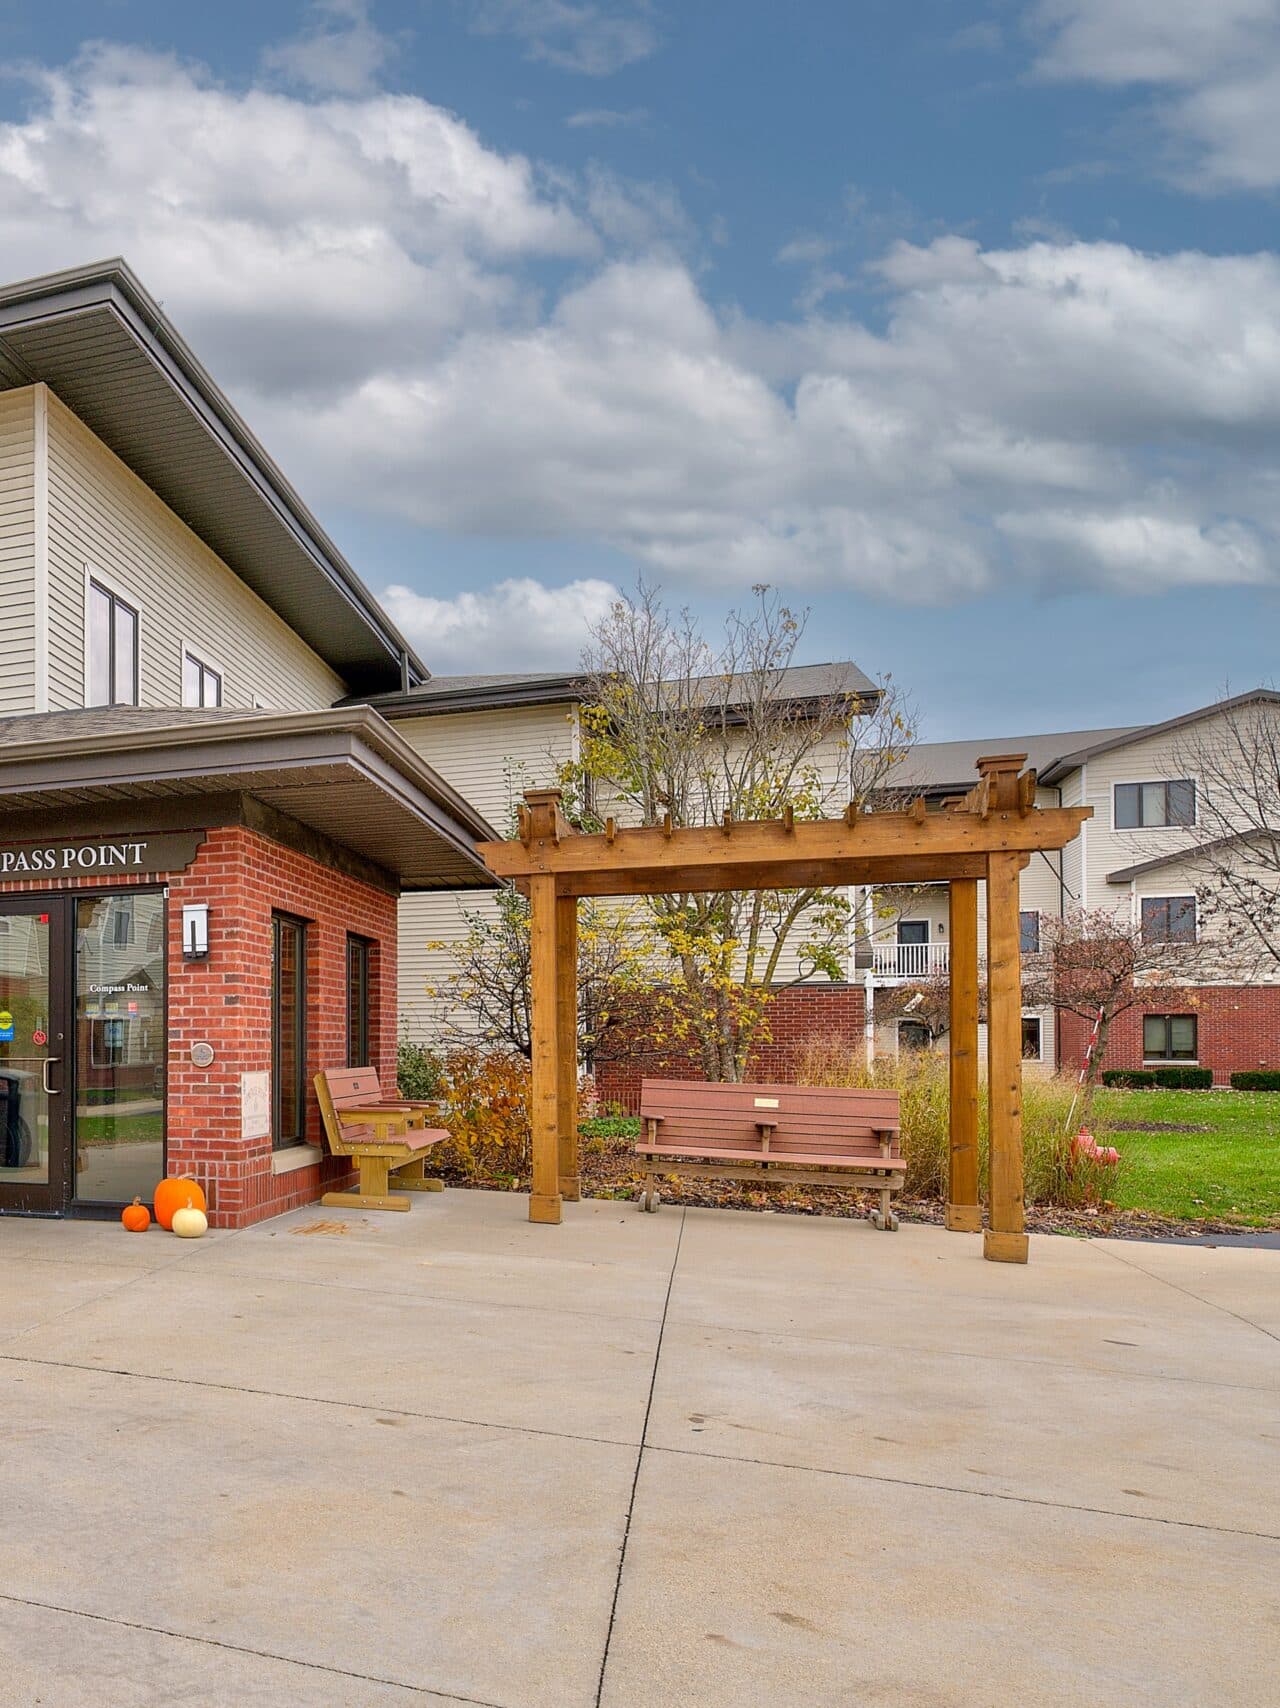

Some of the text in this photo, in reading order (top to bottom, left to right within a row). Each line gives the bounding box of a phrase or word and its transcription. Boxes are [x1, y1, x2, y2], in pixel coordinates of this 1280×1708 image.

[61, 843, 147, 869] POINT
[89, 984, 148, 994] Compass Point
